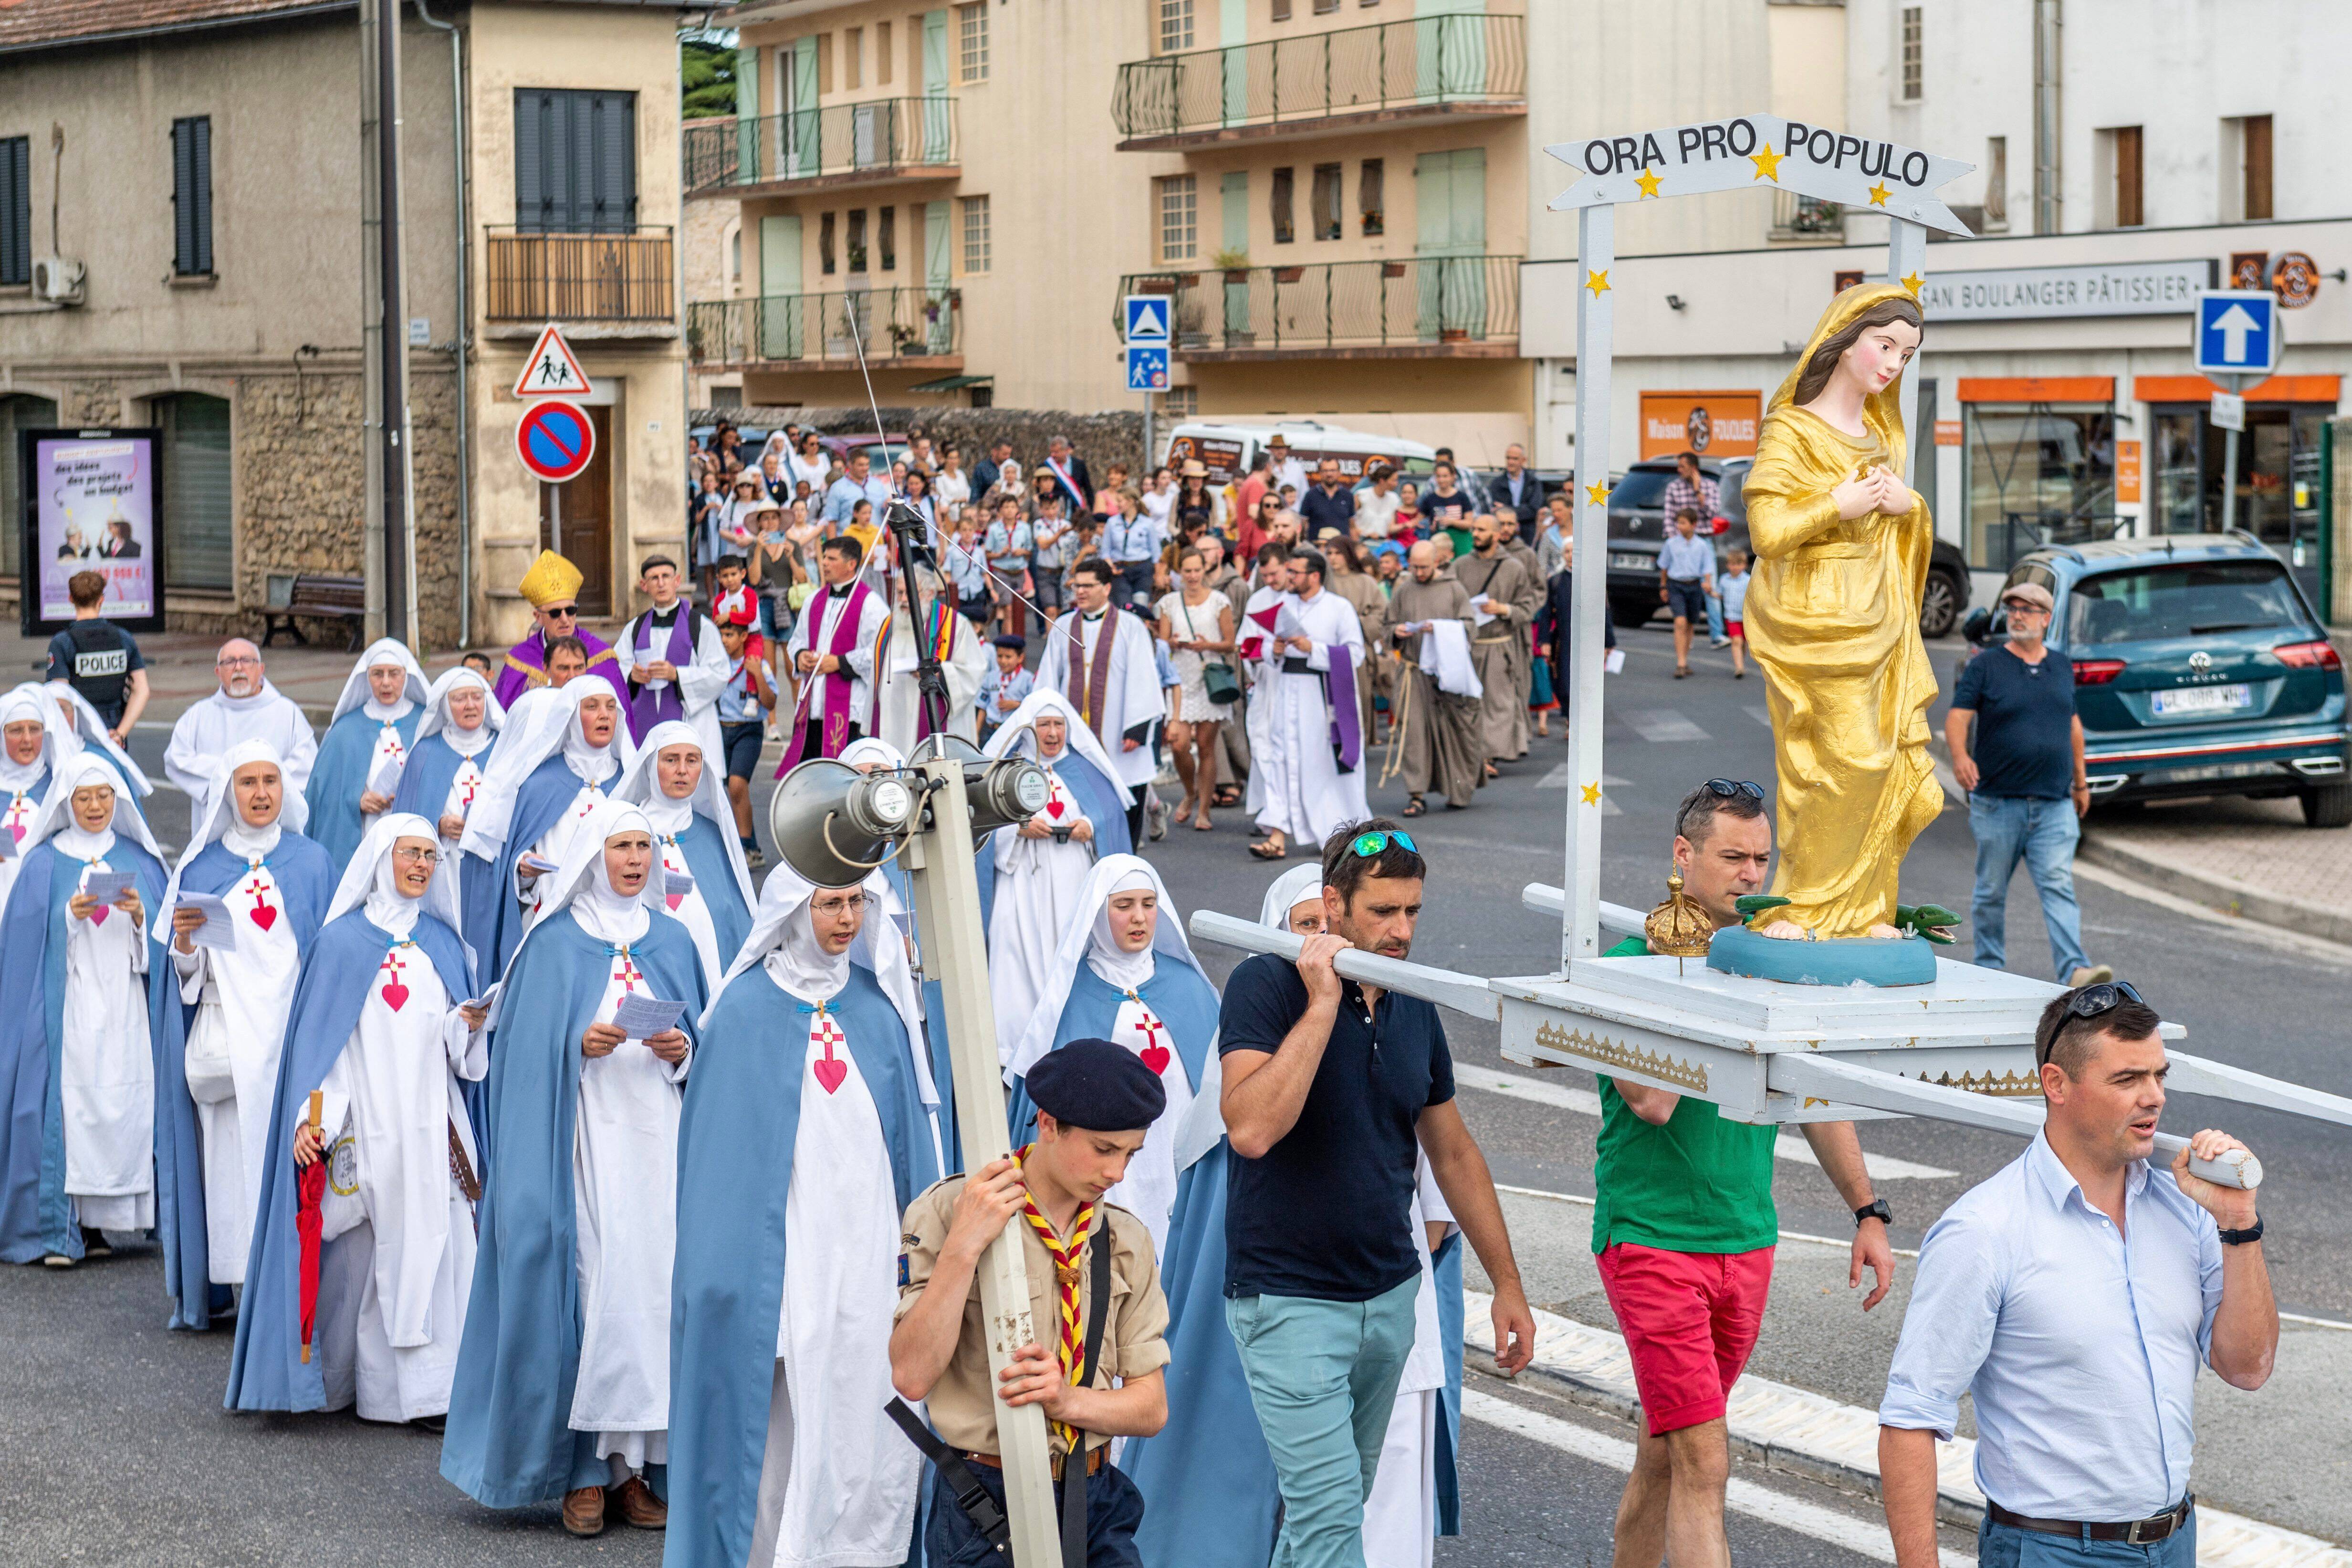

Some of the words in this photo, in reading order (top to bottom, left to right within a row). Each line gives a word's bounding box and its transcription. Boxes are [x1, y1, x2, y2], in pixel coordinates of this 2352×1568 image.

[1585, 134, 1666, 175] ORA
[1678, 119, 1756, 164] PRO
[1785, 122, 1928, 187] POPULO
[1962, 281, 2078, 308] BOULANGER
[2087, 273, 2189, 303] PÂTISSIER
[1648, 418, 1684, 439] Maison
[1712, 418, 1756, 441] FOUQUES
[99, 484, 133, 496] budget
[80, 654, 125, 672] POLICE
